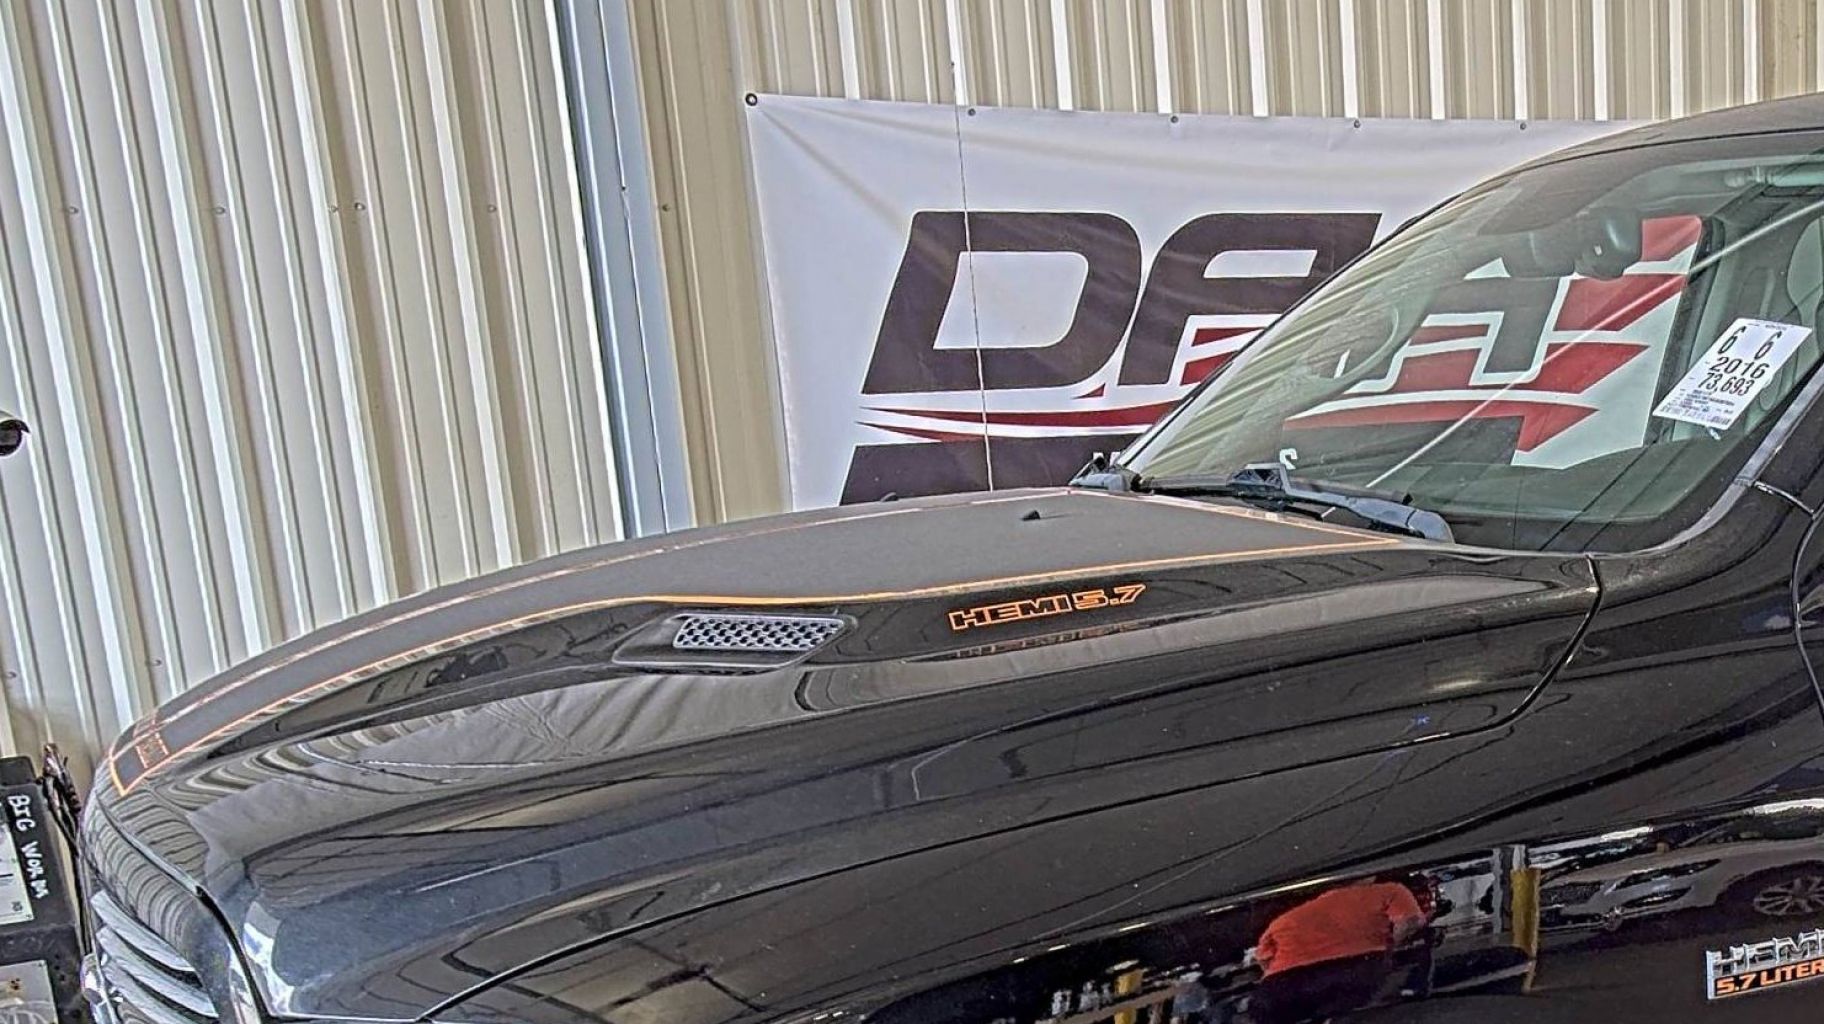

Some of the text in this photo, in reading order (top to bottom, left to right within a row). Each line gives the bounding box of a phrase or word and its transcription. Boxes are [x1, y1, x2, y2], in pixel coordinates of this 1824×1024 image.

[1717, 325, 1783, 360] 6 6
[1709, 356, 1770, 379] 2016
[949, 584, 1146, 630] HEMI 5.7
[7, 794, 36, 832] BIG
[1716, 973, 1757, 995] 5.7
